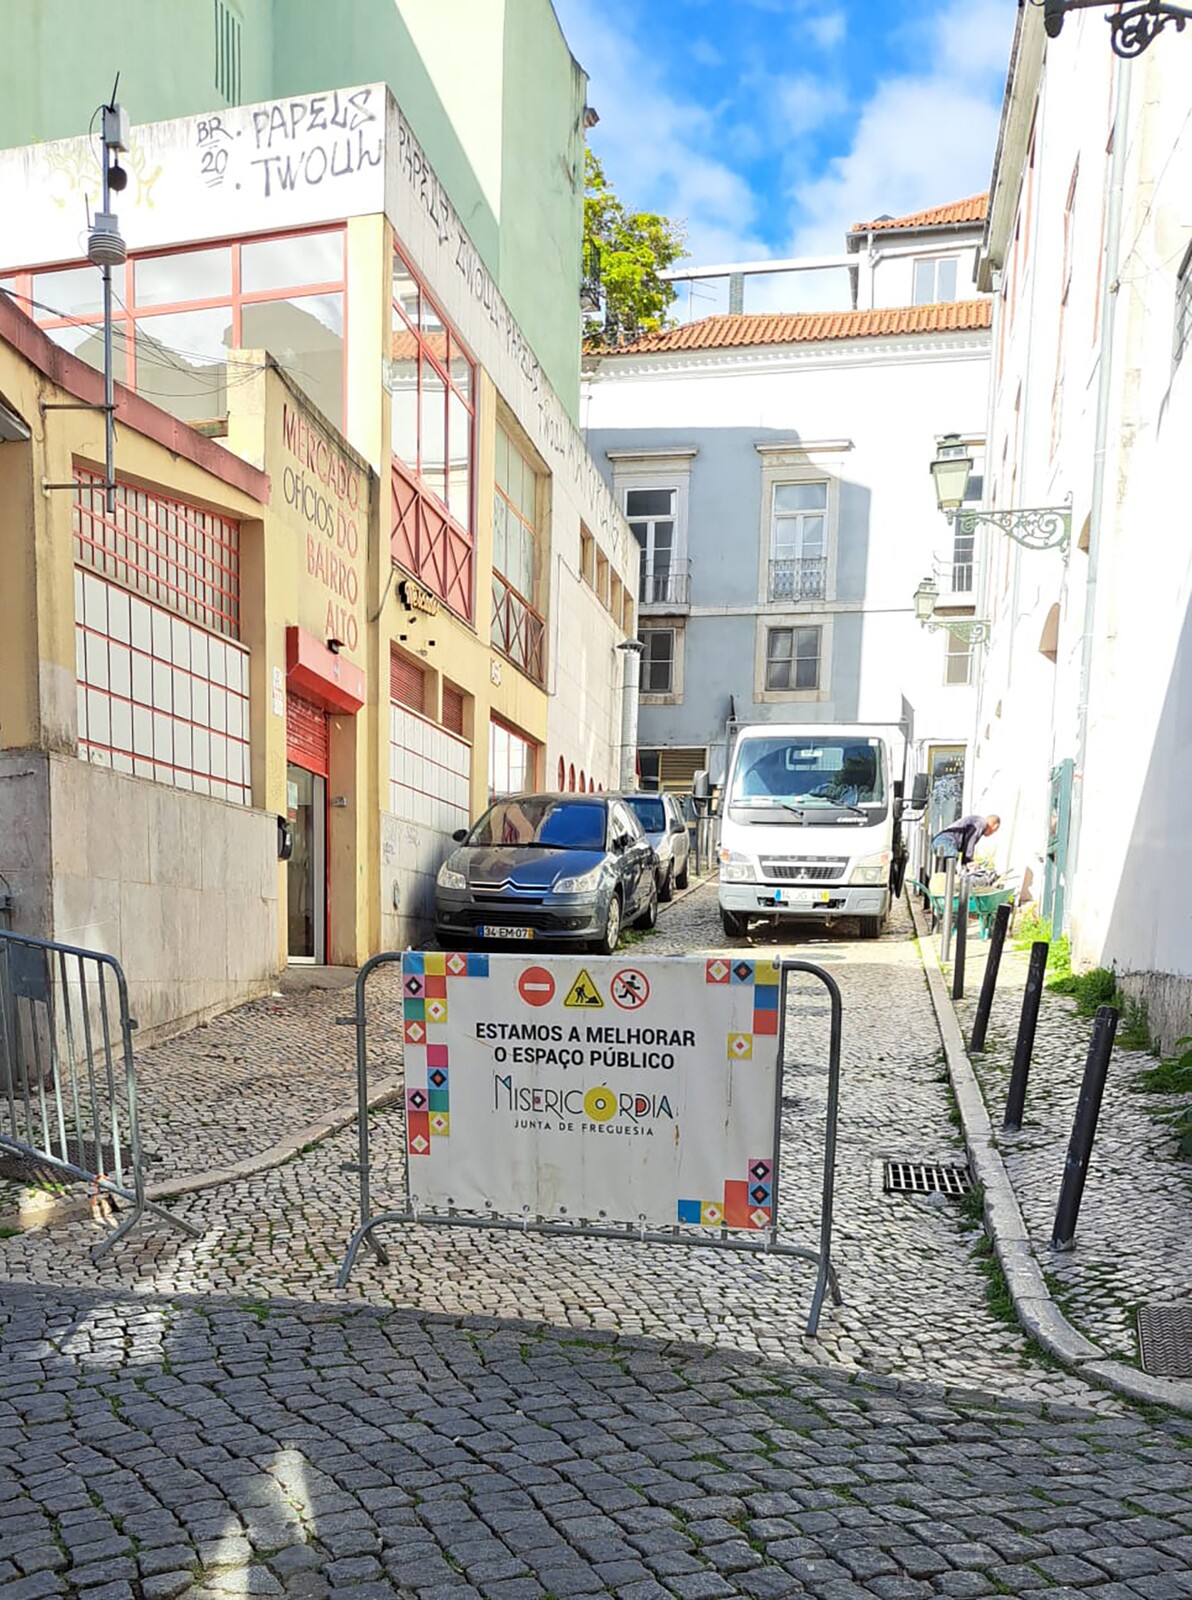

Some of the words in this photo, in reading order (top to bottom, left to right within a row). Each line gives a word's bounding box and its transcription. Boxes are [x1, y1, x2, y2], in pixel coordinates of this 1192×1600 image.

[283, 403, 359, 512] MERCADO
[283, 466, 335, 539] OFÍCIOS
[335, 507, 359, 559] DO
[306, 532, 359, 606] BAIRRO
[324, 599, 359, 652] ALTO
[475, 1022, 563, 1042] ESTAMOS
[568, 1026, 581, 1043] A
[586, 1026, 696, 1047] MELHORAR
[494, 1046, 507, 1063] O
[512, 1047, 584, 1069] ESPAÇO
[590, 1046, 675, 1070] PÚBLICO
[514, 1119, 552, 1131] JUNTA
[558, 1122, 574, 1132] DE
[581, 1123, 655, 1136] FREGUESIA
